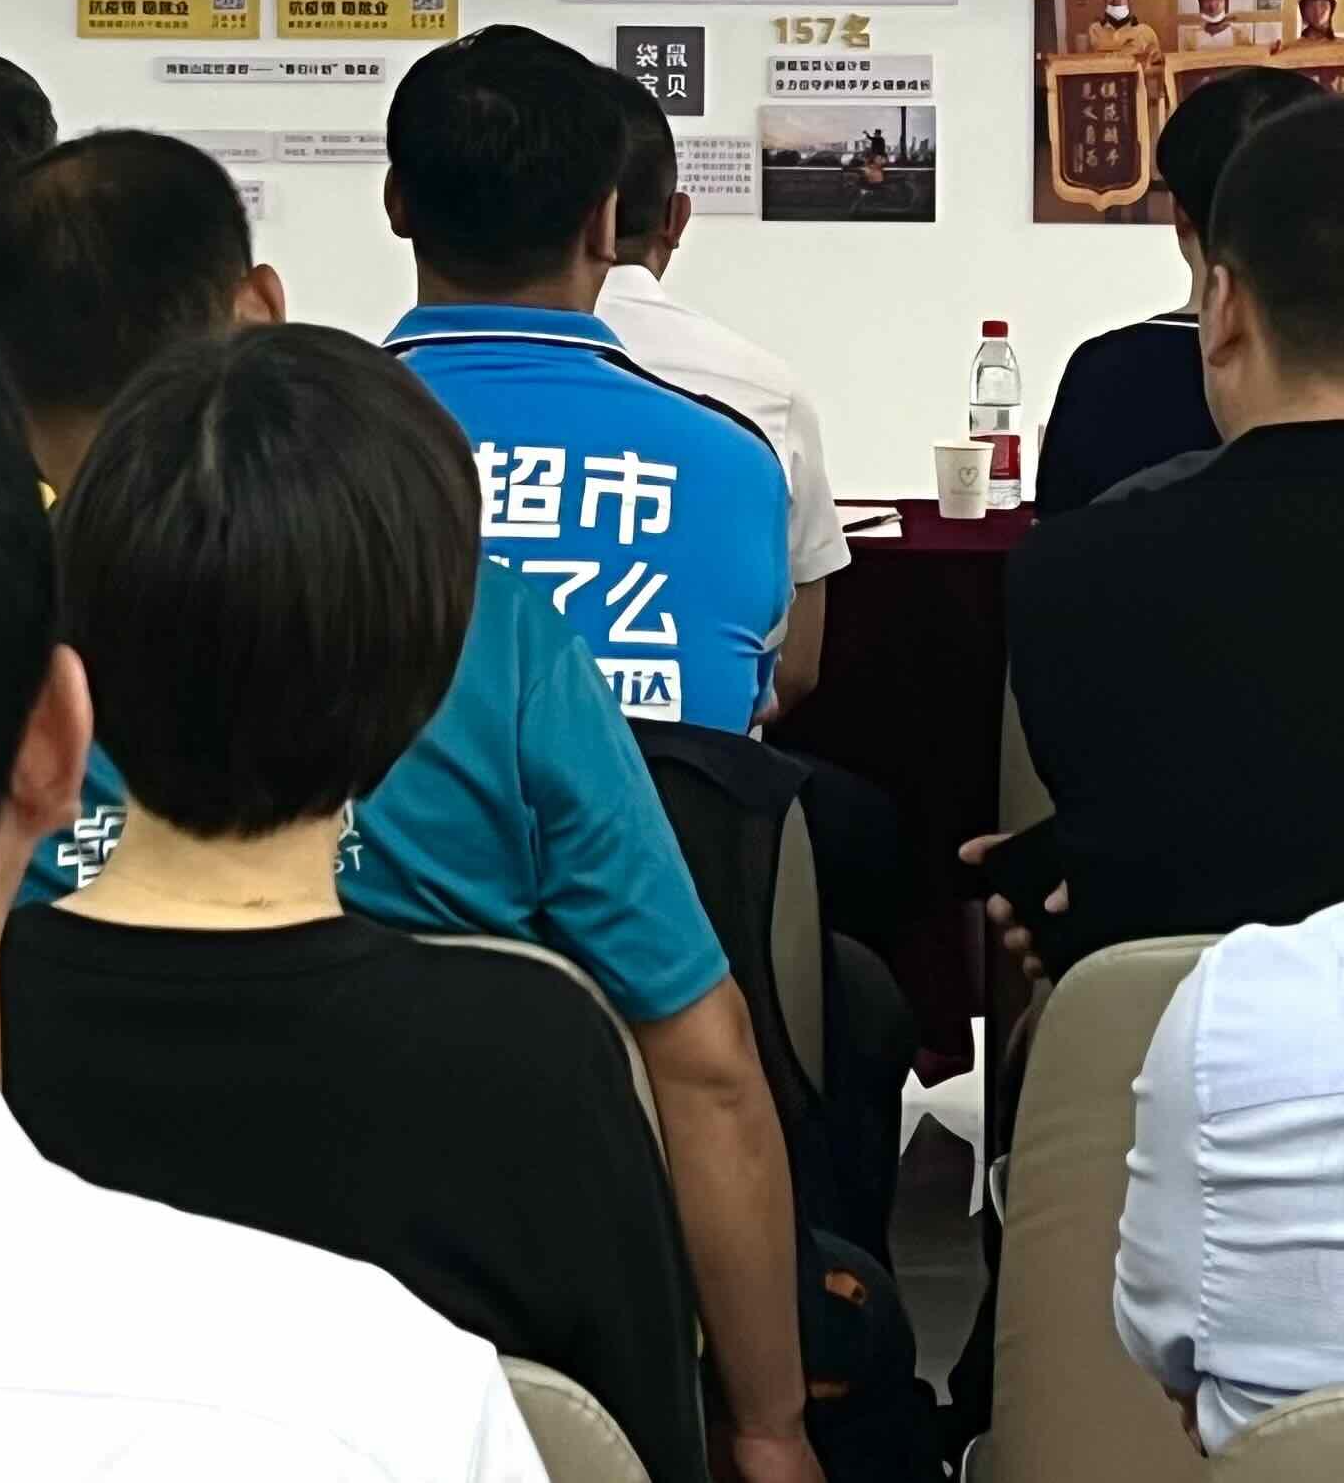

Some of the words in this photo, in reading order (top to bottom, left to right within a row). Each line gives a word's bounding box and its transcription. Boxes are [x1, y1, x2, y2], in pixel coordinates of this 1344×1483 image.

[635, 42, 688, 68] 袋鼠
[769, 13, 872, 50] 157名
[473, 440, 679, 546] 超市
[488, 554, 679, 646] 了么
